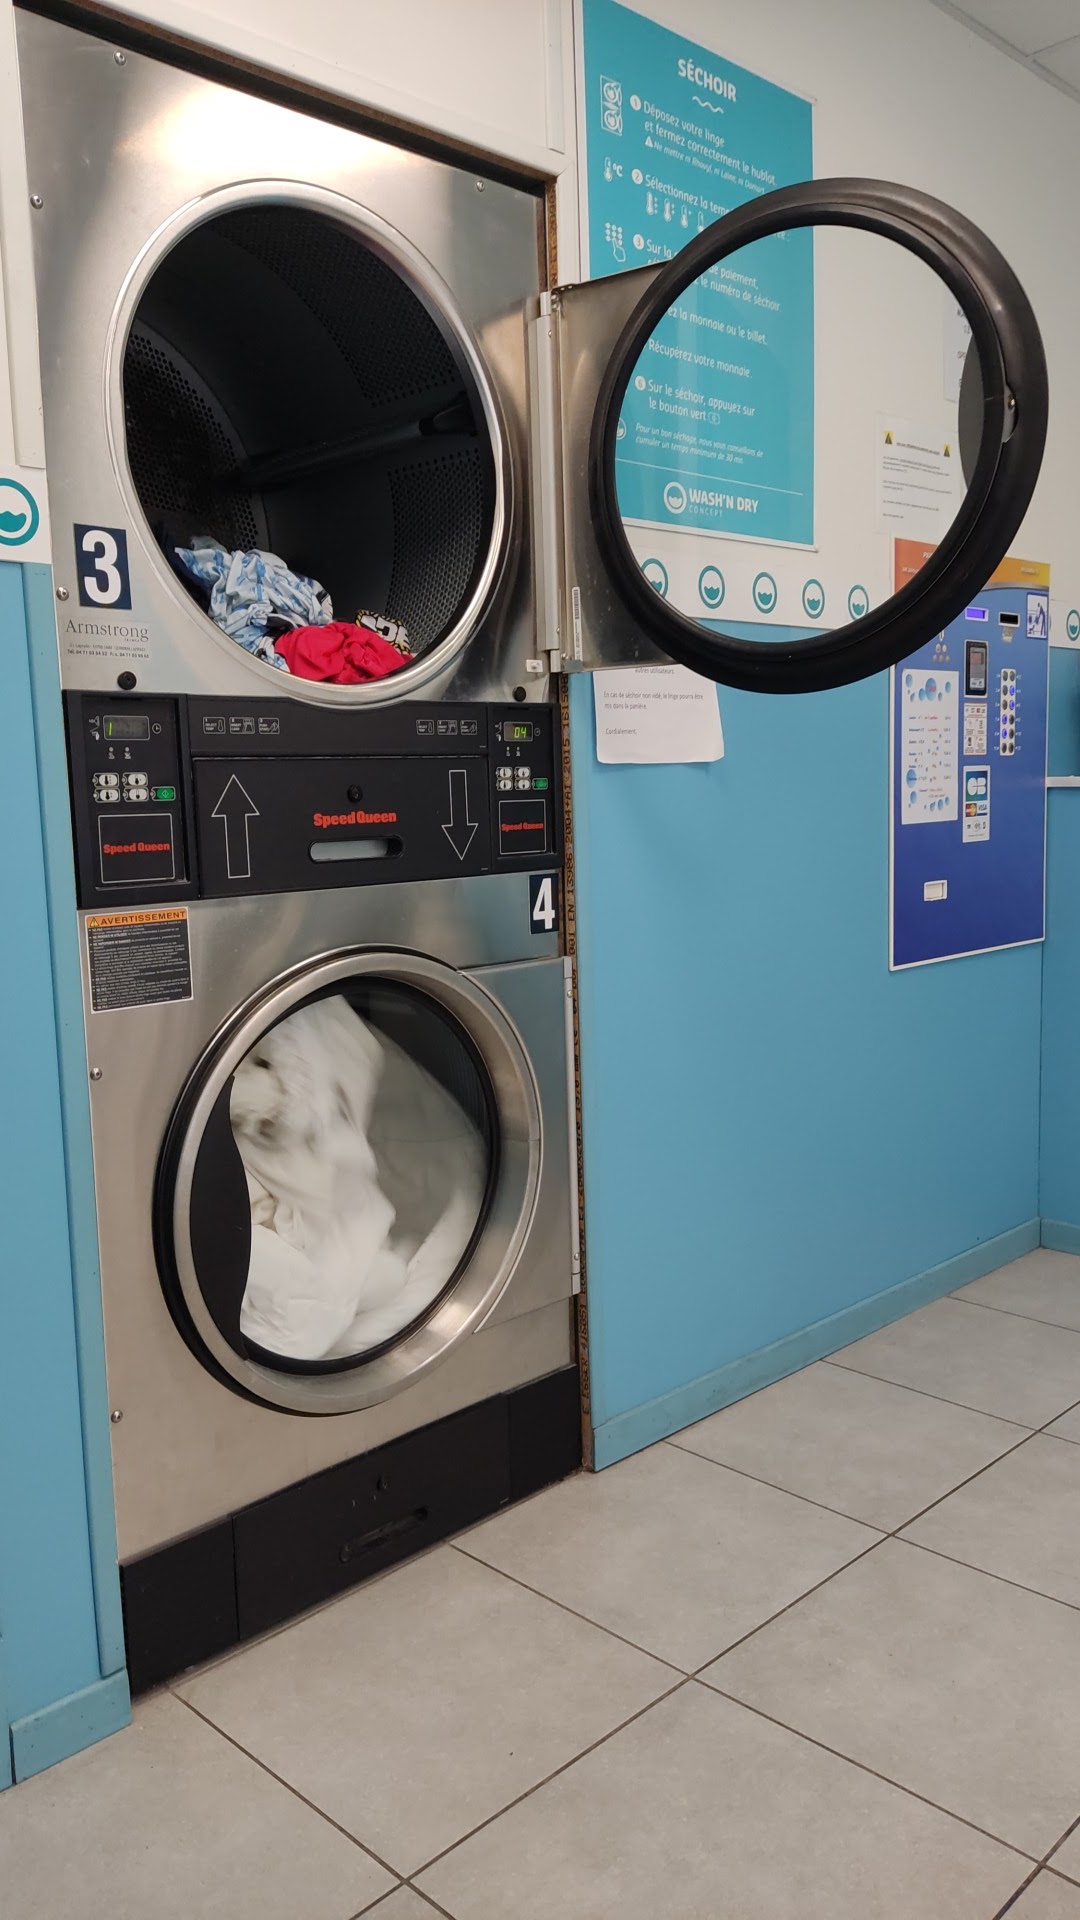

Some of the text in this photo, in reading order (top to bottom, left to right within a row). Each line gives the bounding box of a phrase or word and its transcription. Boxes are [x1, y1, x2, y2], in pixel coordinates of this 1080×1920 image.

[677, 58, 737, 103] SÉCHOIR
[643, 100, 680, 127] Déposez
[682, 120, 703, 137] votre
[705, 127, 725, 148] linge
[644, 121, 653, 133] et
[656, 123, 686, 147] fermez
[687, 139, 740, 171] correctement
[742, 161, 750, 173] le
[645, 174, 698, 206] Sélectionnez
[700, 195, 708, 210] la
[646, 239, 662, 255] Sur
[664, 244, 672, 258] la
[700, 274, 708, 288] le
[710, 280, 741, 299] numéro
[742, 290, 752, 302] de
[720, 267, 759, 290] paiement,
[679, 307, 688, 320] la
[689, 313, 725, 331] monnaie
[726, 325, 737, 336] ou
[738, 326, 745, 338] le
[648, 338, 693, 361] Récupérez
[694, 353, 715, 368] votre
[648, 379, 663, 394] Sur
[665, 383, 673, 397] le
[674, 386, 706, 406] séchoir,
[708, 397, 741, 414] appuyez
[742, 405, 755, 417] sur
[649, 396, 706, 421] le bouton vert
[635, 422, 651, 434] Pour
[651, 427, 660, 436] un
[661, 428, 672, 439] bon
[699, 438, 712, 448] nous
[713, 440, 726, 450] vous
[726, 444, 756, 457] conseillons
[756, 448, 764, 458] de
[635, 436, 661, 448] cumuler
[661, 440, 670, 449] un
[671, 441, 689, 454] temps
[690, 447, 717, 459] minimum
[718, 451, 725, 460] de
[688, 487, 759, 514] WASH'N DRY
[688, 504, 723, 518] CONCEPT
[82, 529, 122, 605] 3
[65, 618, 149, 642] Armstrong
[513, 726, 527, 739] 04
[313, 810, 397, 828] Speed Queen
[501, 822, 544, 832] Speed Queen
[103, 842, 170, 855] Speed Queen
[533, 877, 555, 930] 4
[100, 910, 186, 926] AVERTISSEMENT
